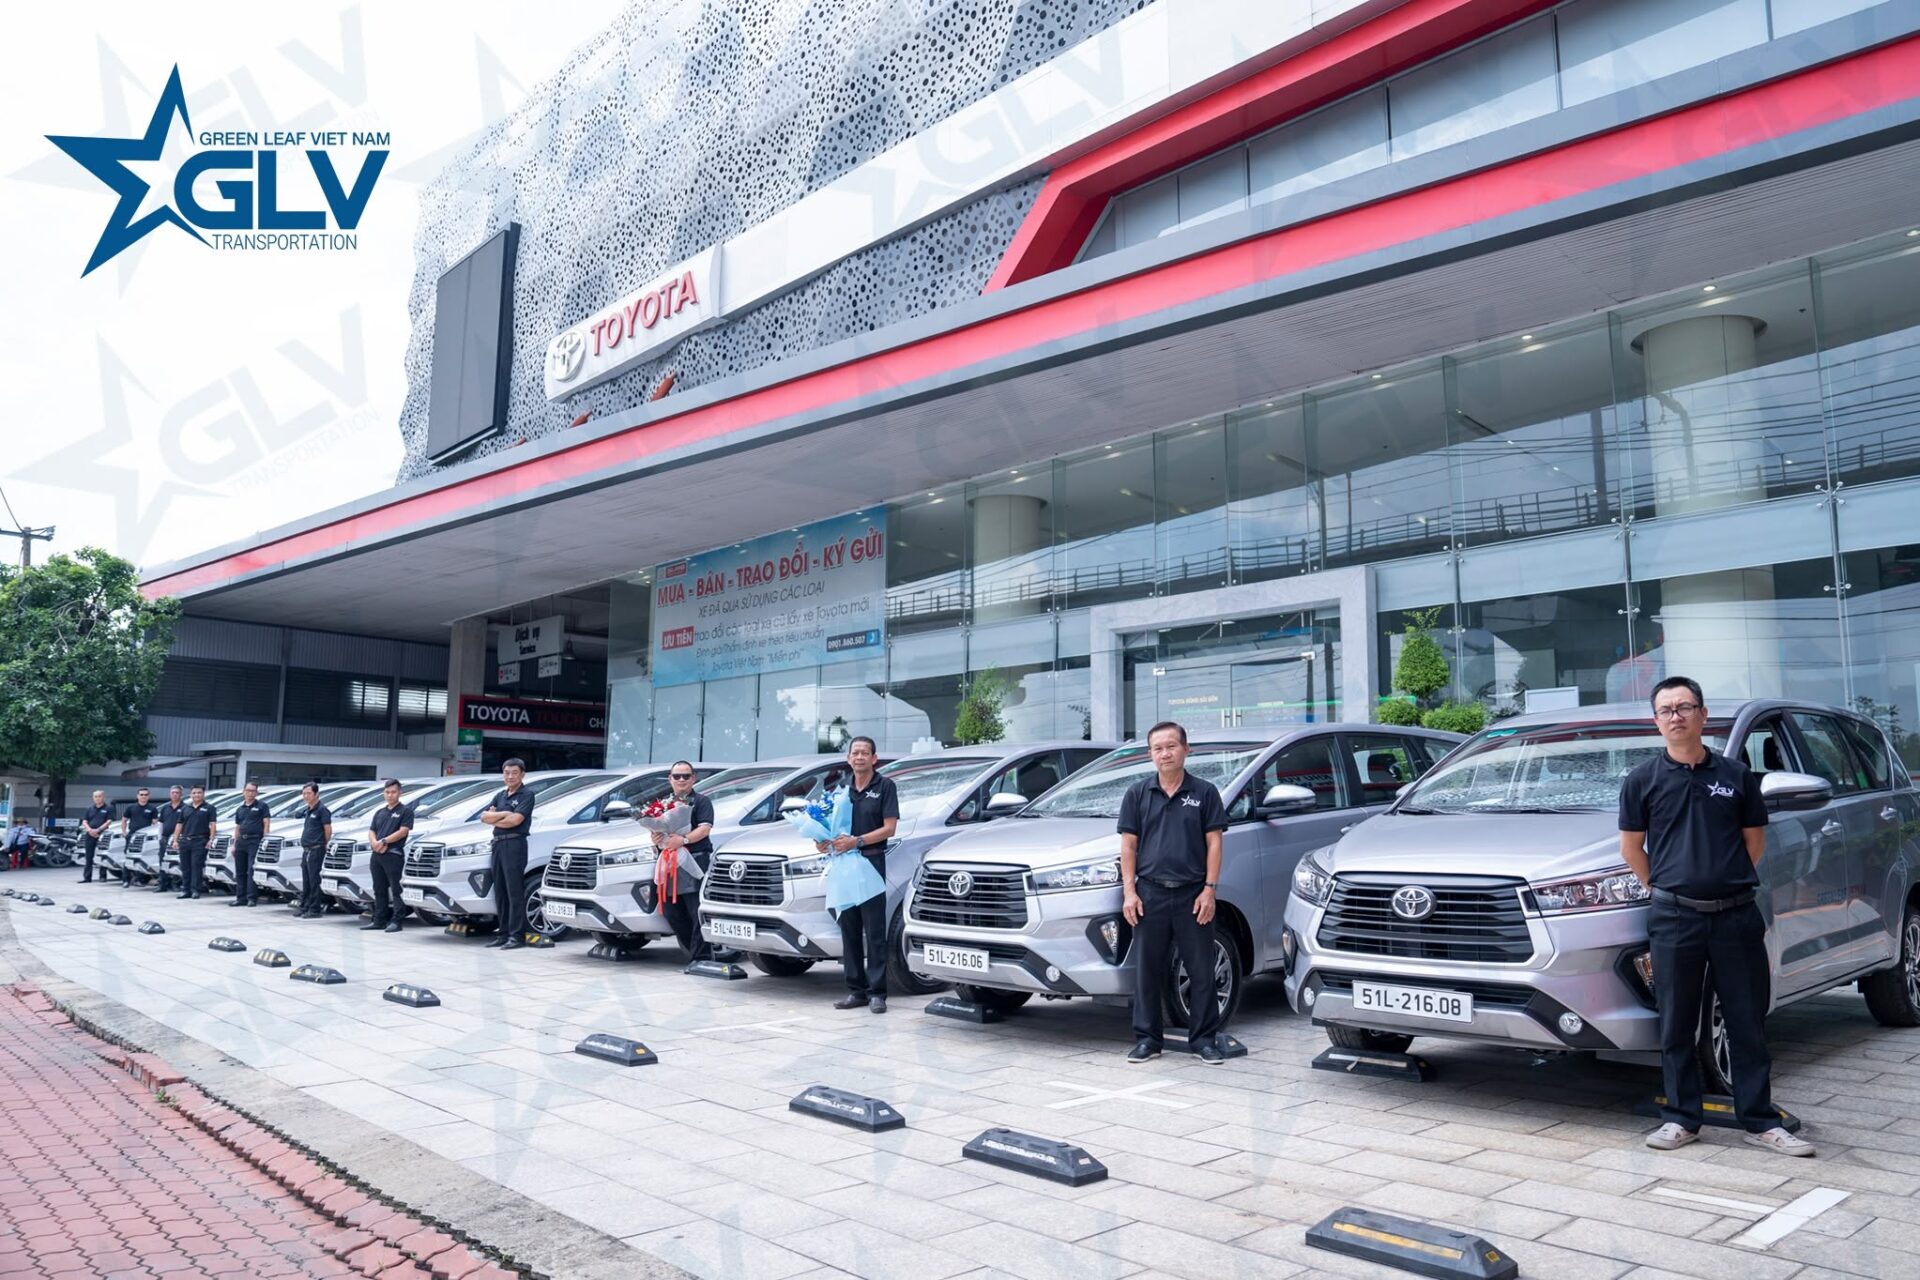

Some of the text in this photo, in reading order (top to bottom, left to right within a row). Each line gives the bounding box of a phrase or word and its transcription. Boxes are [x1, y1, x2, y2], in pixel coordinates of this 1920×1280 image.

[590, 270, 698, 356] TOYOTA
[657, 583, 685, 606] MUA
[696, 570, 726, 599] BÁN
[736, 560, 775, 590] TRAO
[778, 541, 810, 580] ĐỔI
[823, 536, 846, 570] KÝ
[850, 527, 884, 564] GỬI
[698, 605, 708, 618] XE
[709, 601, 721, 616] ĐÃ
[722, 600, 740, 613] QUA
[752, 590, 779, 608] DỤNG
[780, 583, 801, 601] CÁC
[803, 580, 825, 598] LOẠI
[803, 610, 814, 622] xe
[816, 602, 849, 621] Toyota
[850, 597, 870, 613] mới
[467, 704, 531, 724] TOYOTA
[1717, 787, 1735, 796] GLV
[714, 921, 752, 938] 51L-419.18
[928, 947, 983, 969] 51L-216.06
[1362, 988, 1461, 1016] 51L-216.08
